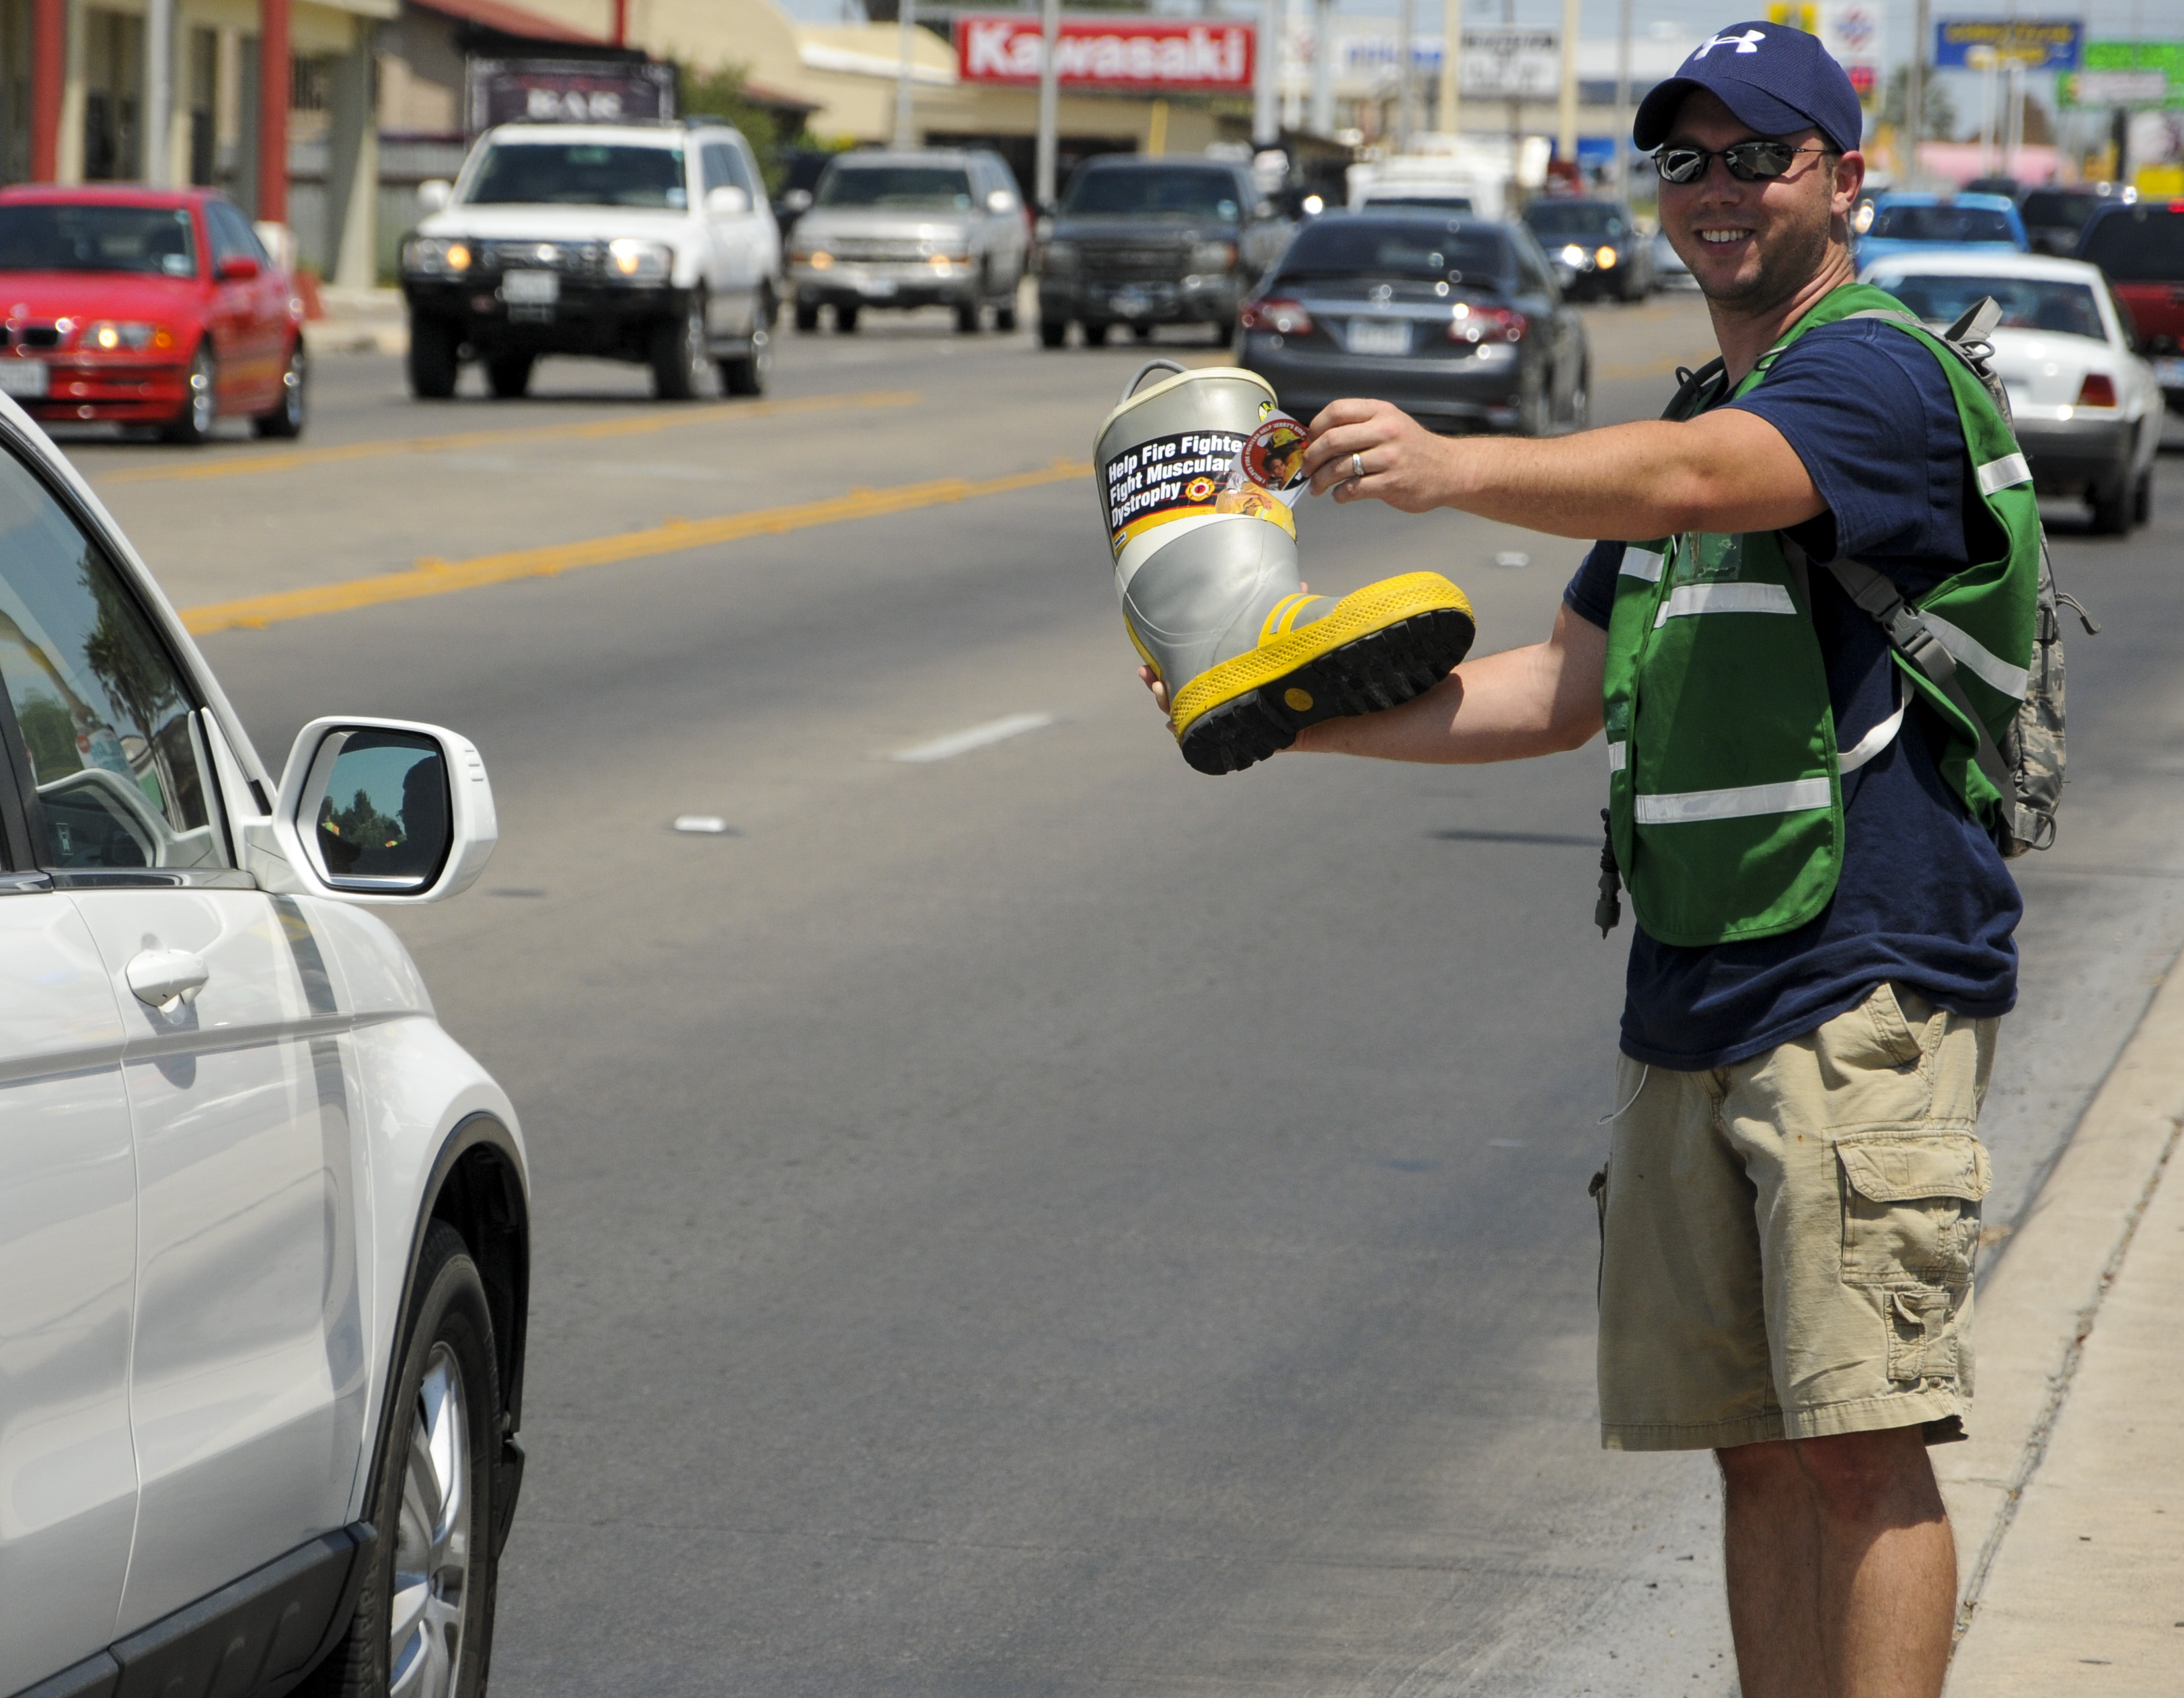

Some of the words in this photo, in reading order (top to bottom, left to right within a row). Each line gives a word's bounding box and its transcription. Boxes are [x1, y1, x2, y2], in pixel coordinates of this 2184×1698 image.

[967, 21, 1245, 81] Kawasaki
[1108, 455, 1138, 484] Help
[1142, 443, 1176, 466] Fire
[1181, 435, 1246, 455] Fighte
[1110, 472, 1143, 507] Fight
[1146, 455, 1233, 485] Muscular
[1112, 482, 1181, 528] Dystrophy
